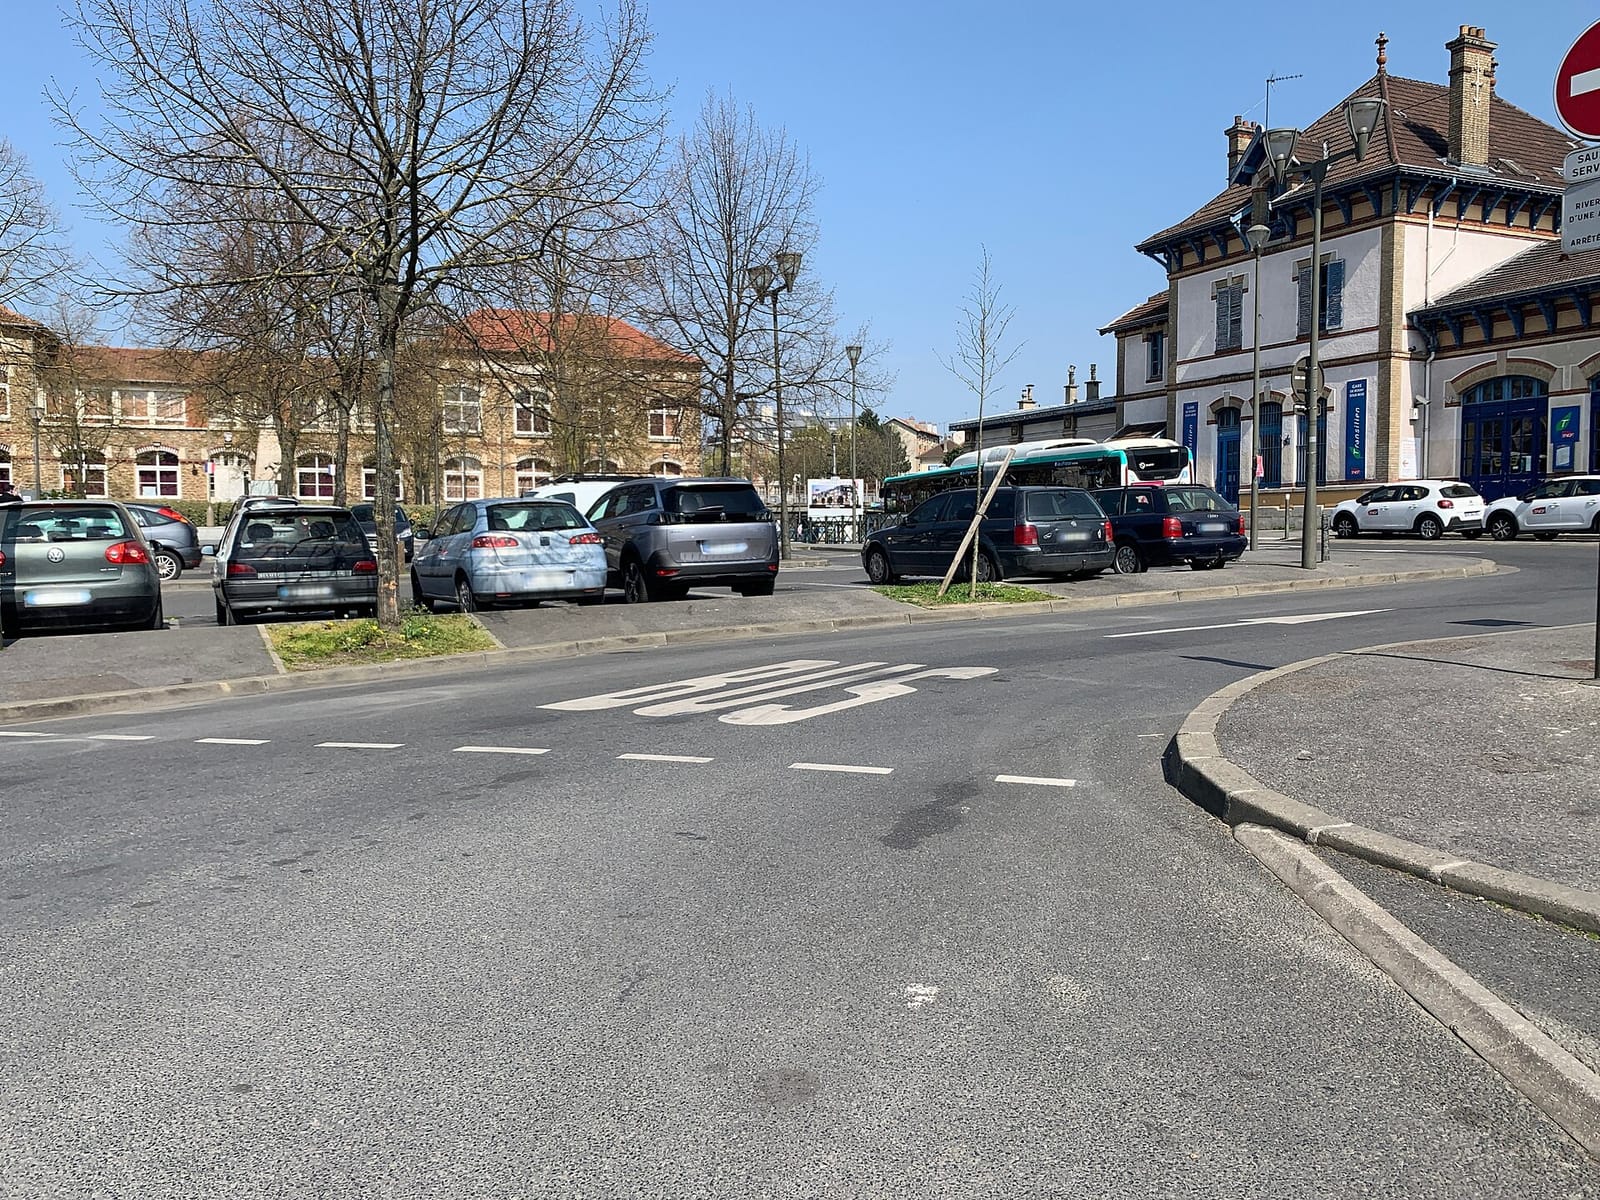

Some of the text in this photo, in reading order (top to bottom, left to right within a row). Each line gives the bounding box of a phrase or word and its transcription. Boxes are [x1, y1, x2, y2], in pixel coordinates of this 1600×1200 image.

[1569, 211, 1595, 223] D'UNE
[1353, 407, 1361, 455] Transilien
[536, 659, 999, 726] BUS
